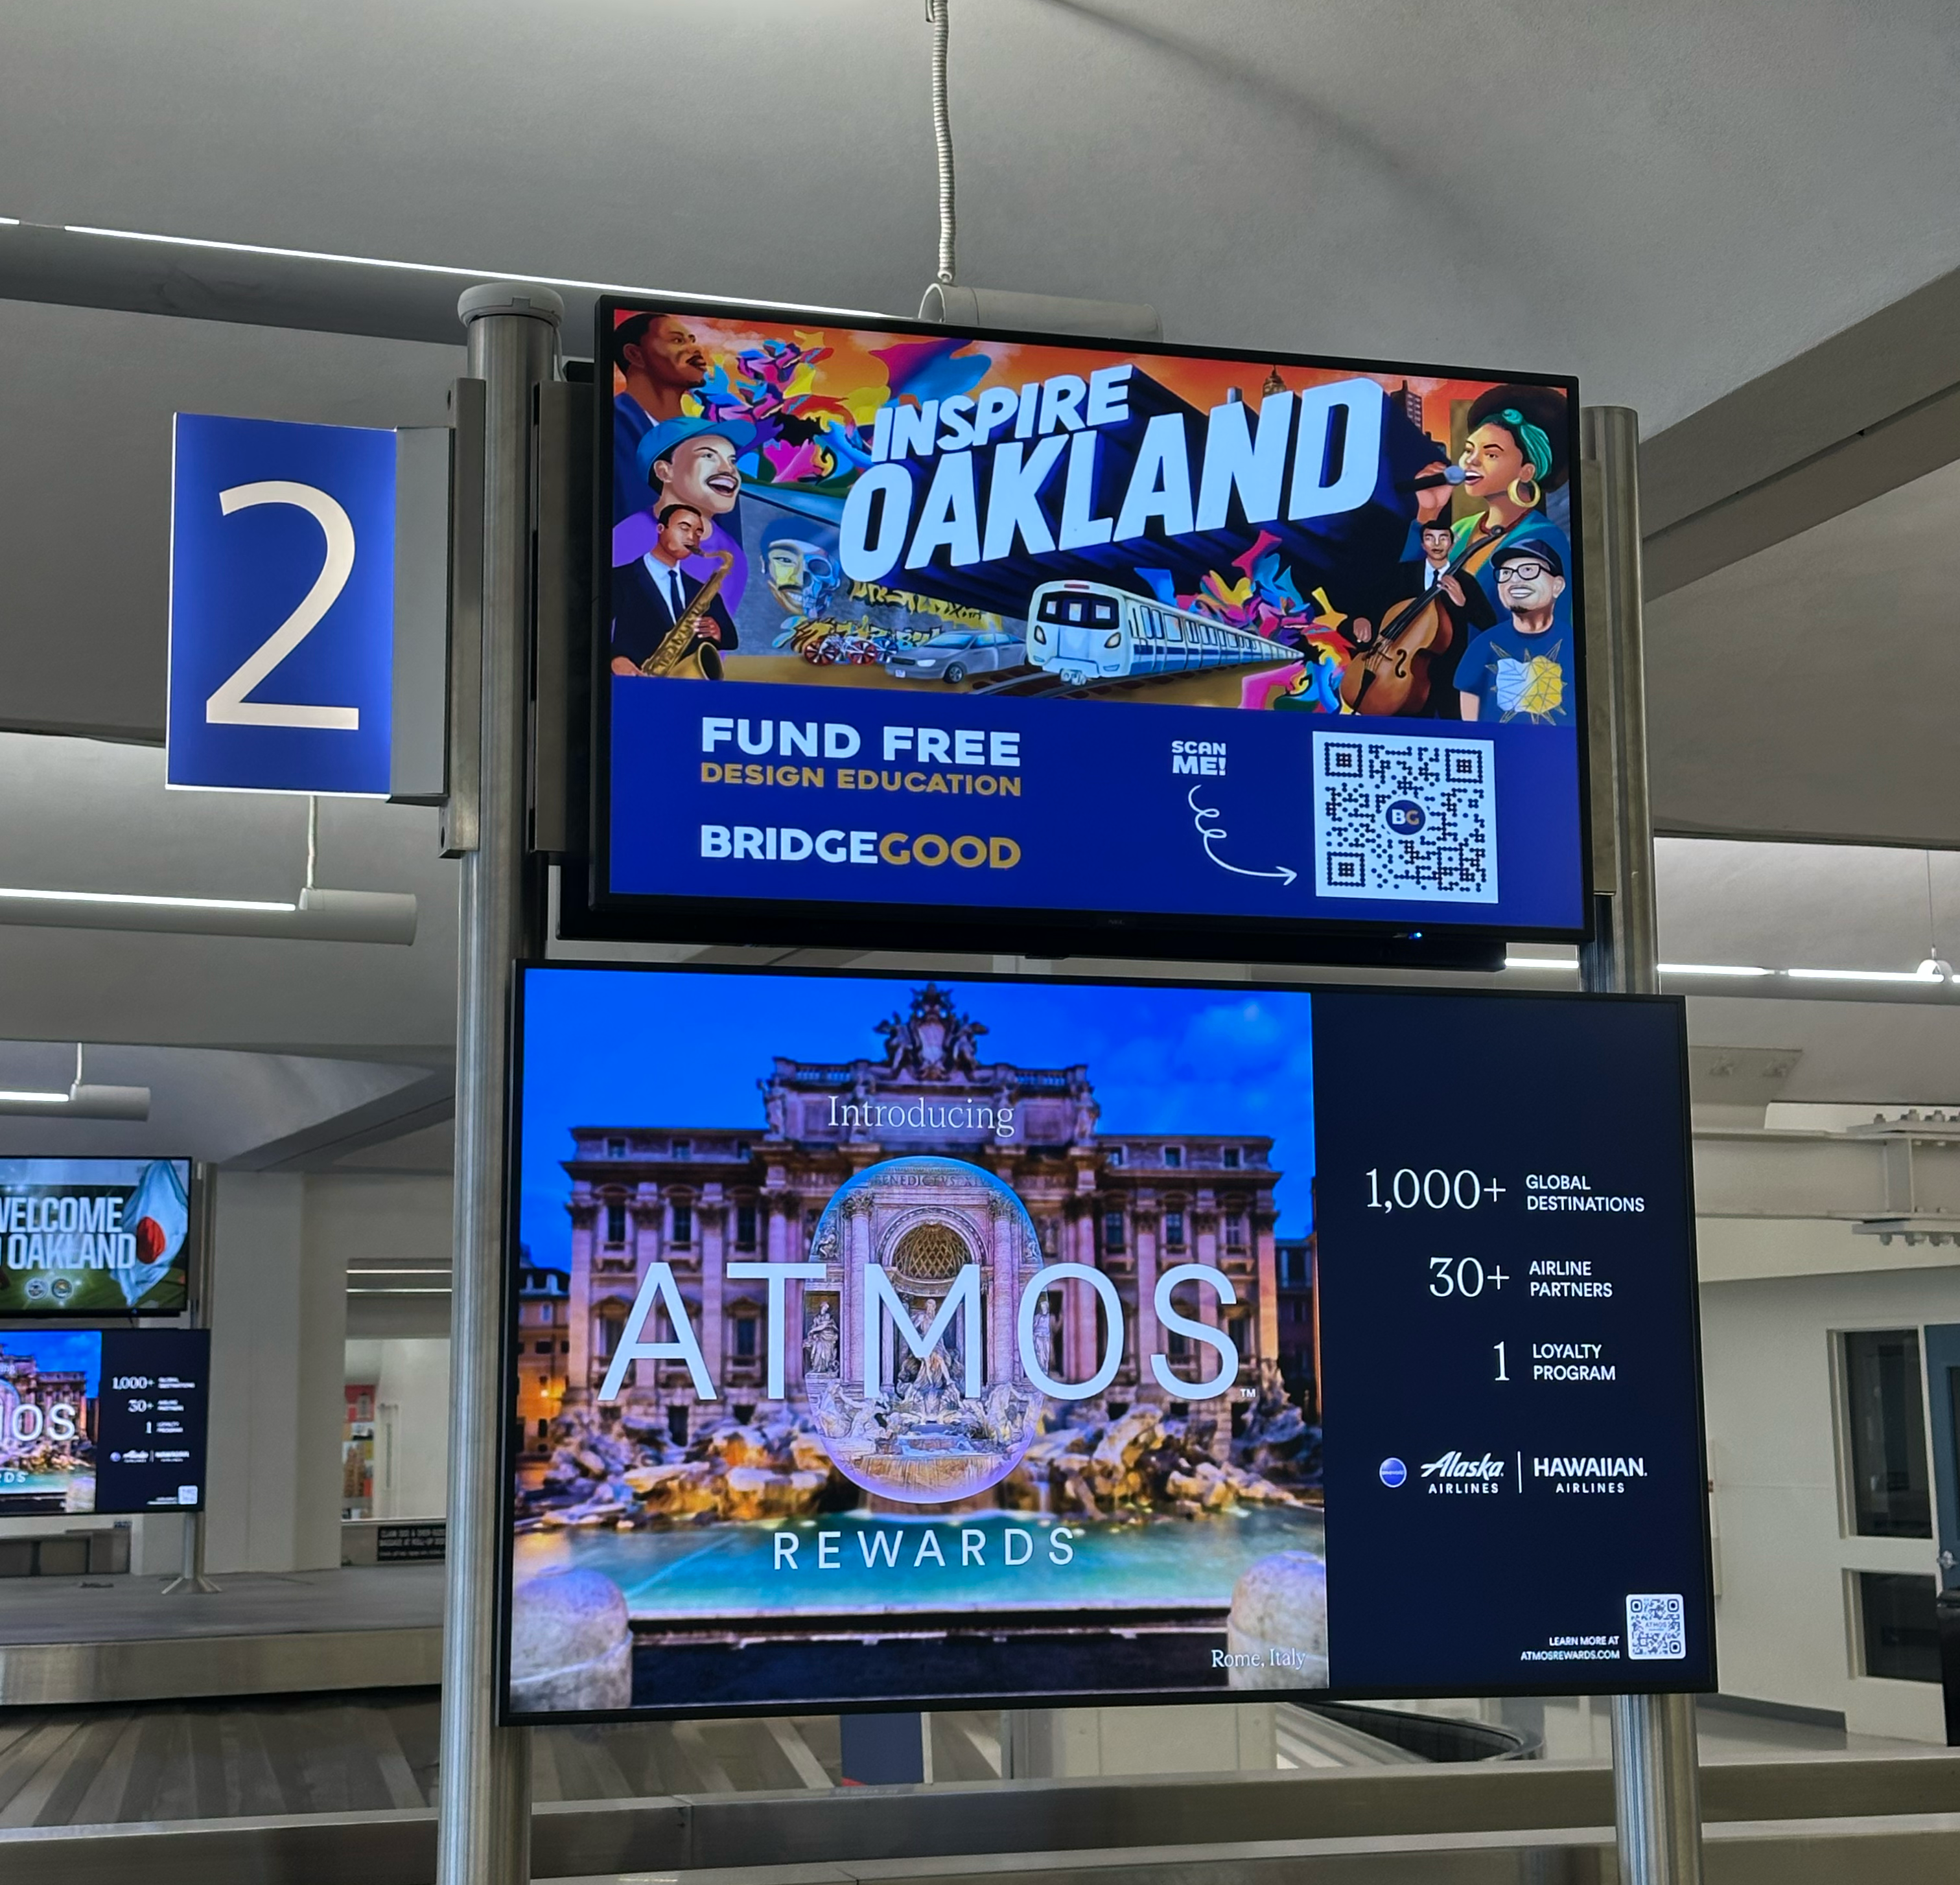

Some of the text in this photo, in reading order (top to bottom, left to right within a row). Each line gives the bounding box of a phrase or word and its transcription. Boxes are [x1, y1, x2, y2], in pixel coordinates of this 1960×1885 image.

[871, 364, 1135, 463] INSPIRE
[839, 377, 1384, 583] OAKLAND
[206, 480, 359, 731] 2
[702, 717, 1021, 767] FUND FREE
[1171, 740, 1226, 756] SCAN
[701, 762, 1021, 796] DESIGN EDUCATION
[1172, 755, 1227, 776] ME!
[701, 824, 1022, 870] BRIDGEGOOD
[828, 1095, 1015, 1138] Introducing
[1366, 1168, 1506, 1214] 1,000+
[1526, 1174, 1591, 1190] GLOBAL
[1526, 1196, 1645, 1212] DESTINATIONS
[8, 1234, 136, 1269] OAKLAND
[1429, 1257, 1510, 1297] 30+
[1529, 1260, 1592, 1276] AIRLINE
[1530, 1282, 1613, 1298] PARTNERS
[598, 1262, 1239, 1401] ATMOS
[1493, 1341, 1510, 1382] 1
[1532, 1343, 1602, 1359] LOYALTY
[1534, 1365, 1616, 1381] PROGRAM
[1428, 1483, 1499, 1494] AIRLINES
[1556, 1482, 1625, 1494] AIRLINES
[773, 1527, 1075, 1571] REWARDS
[1520, 1649, 1620, 1661] ATMOSREWARDS.COM
[1549, 1636, 1620, 1647] LEARN MORE AT
[1211, 1648, 1306, 1670] Rome, Italy
